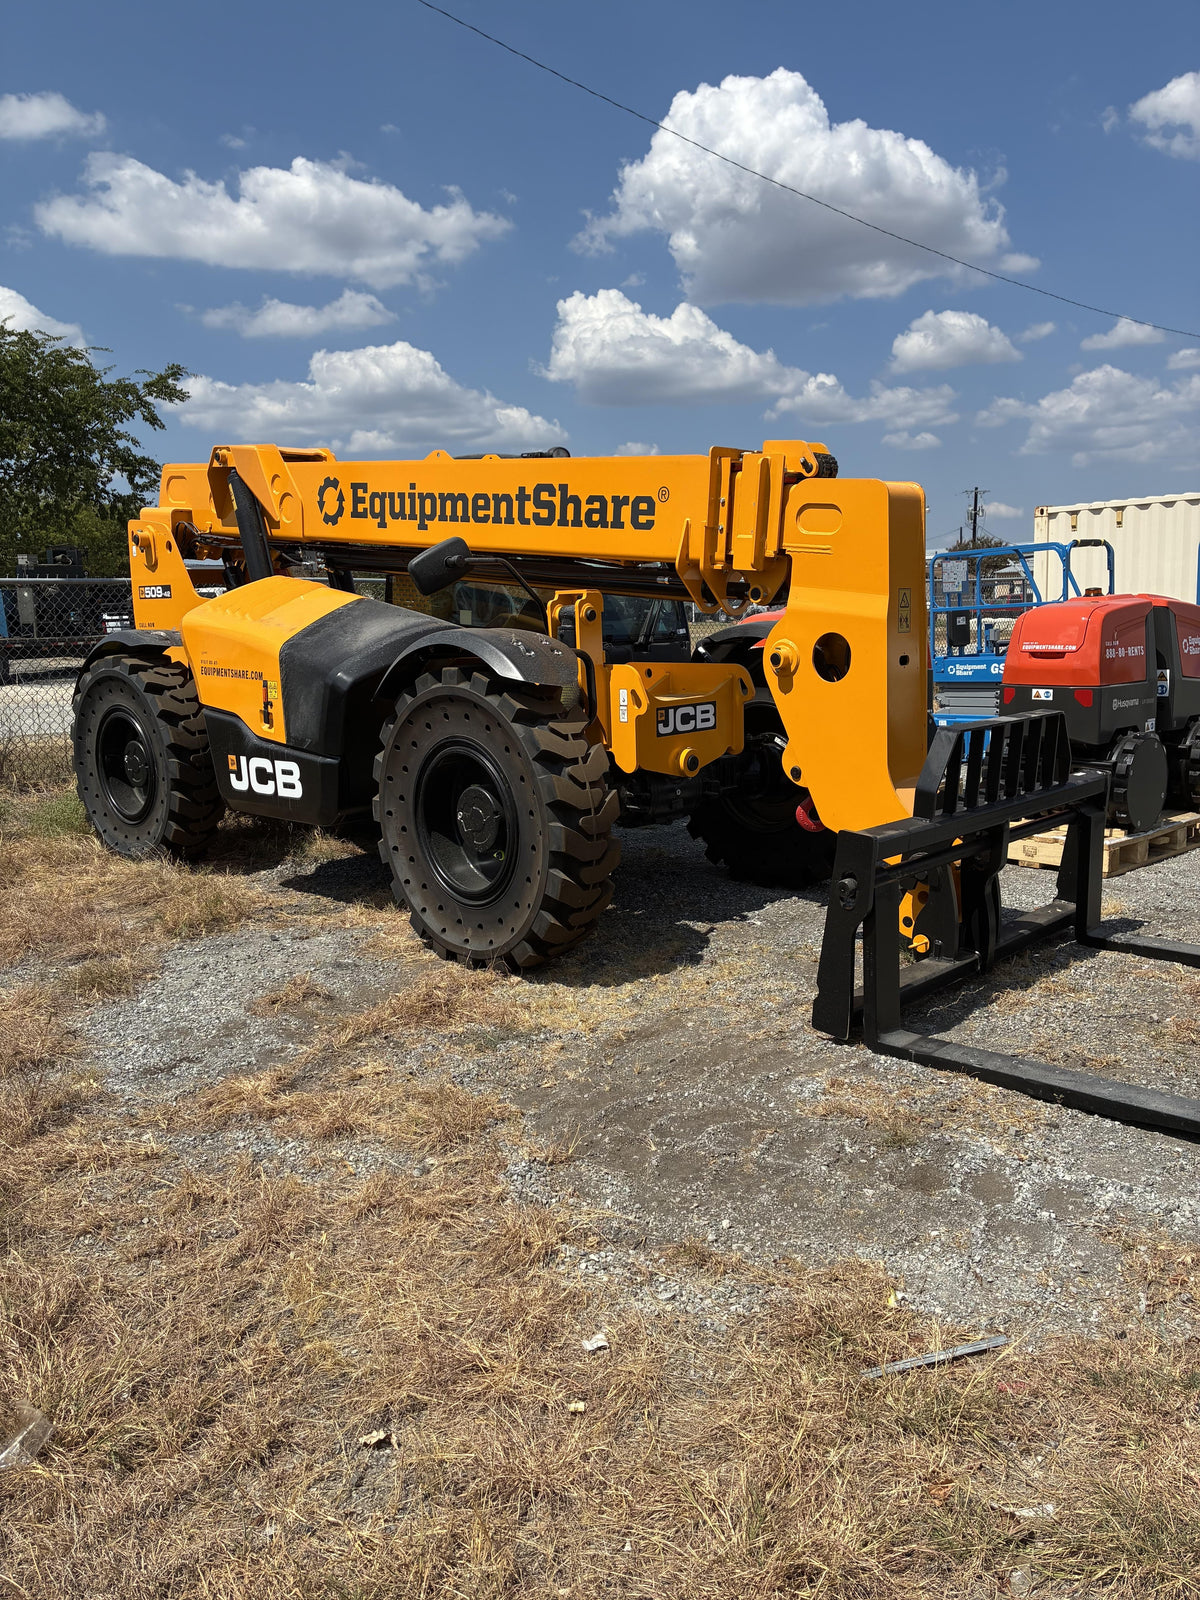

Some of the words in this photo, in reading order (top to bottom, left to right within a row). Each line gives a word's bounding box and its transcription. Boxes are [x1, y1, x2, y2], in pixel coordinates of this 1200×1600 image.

[200, 666, 263, 681] EQUIPMENTSHARE.COM
[658, 703, 716, 735] JCB
[228, 755, 303, 799] JCB
